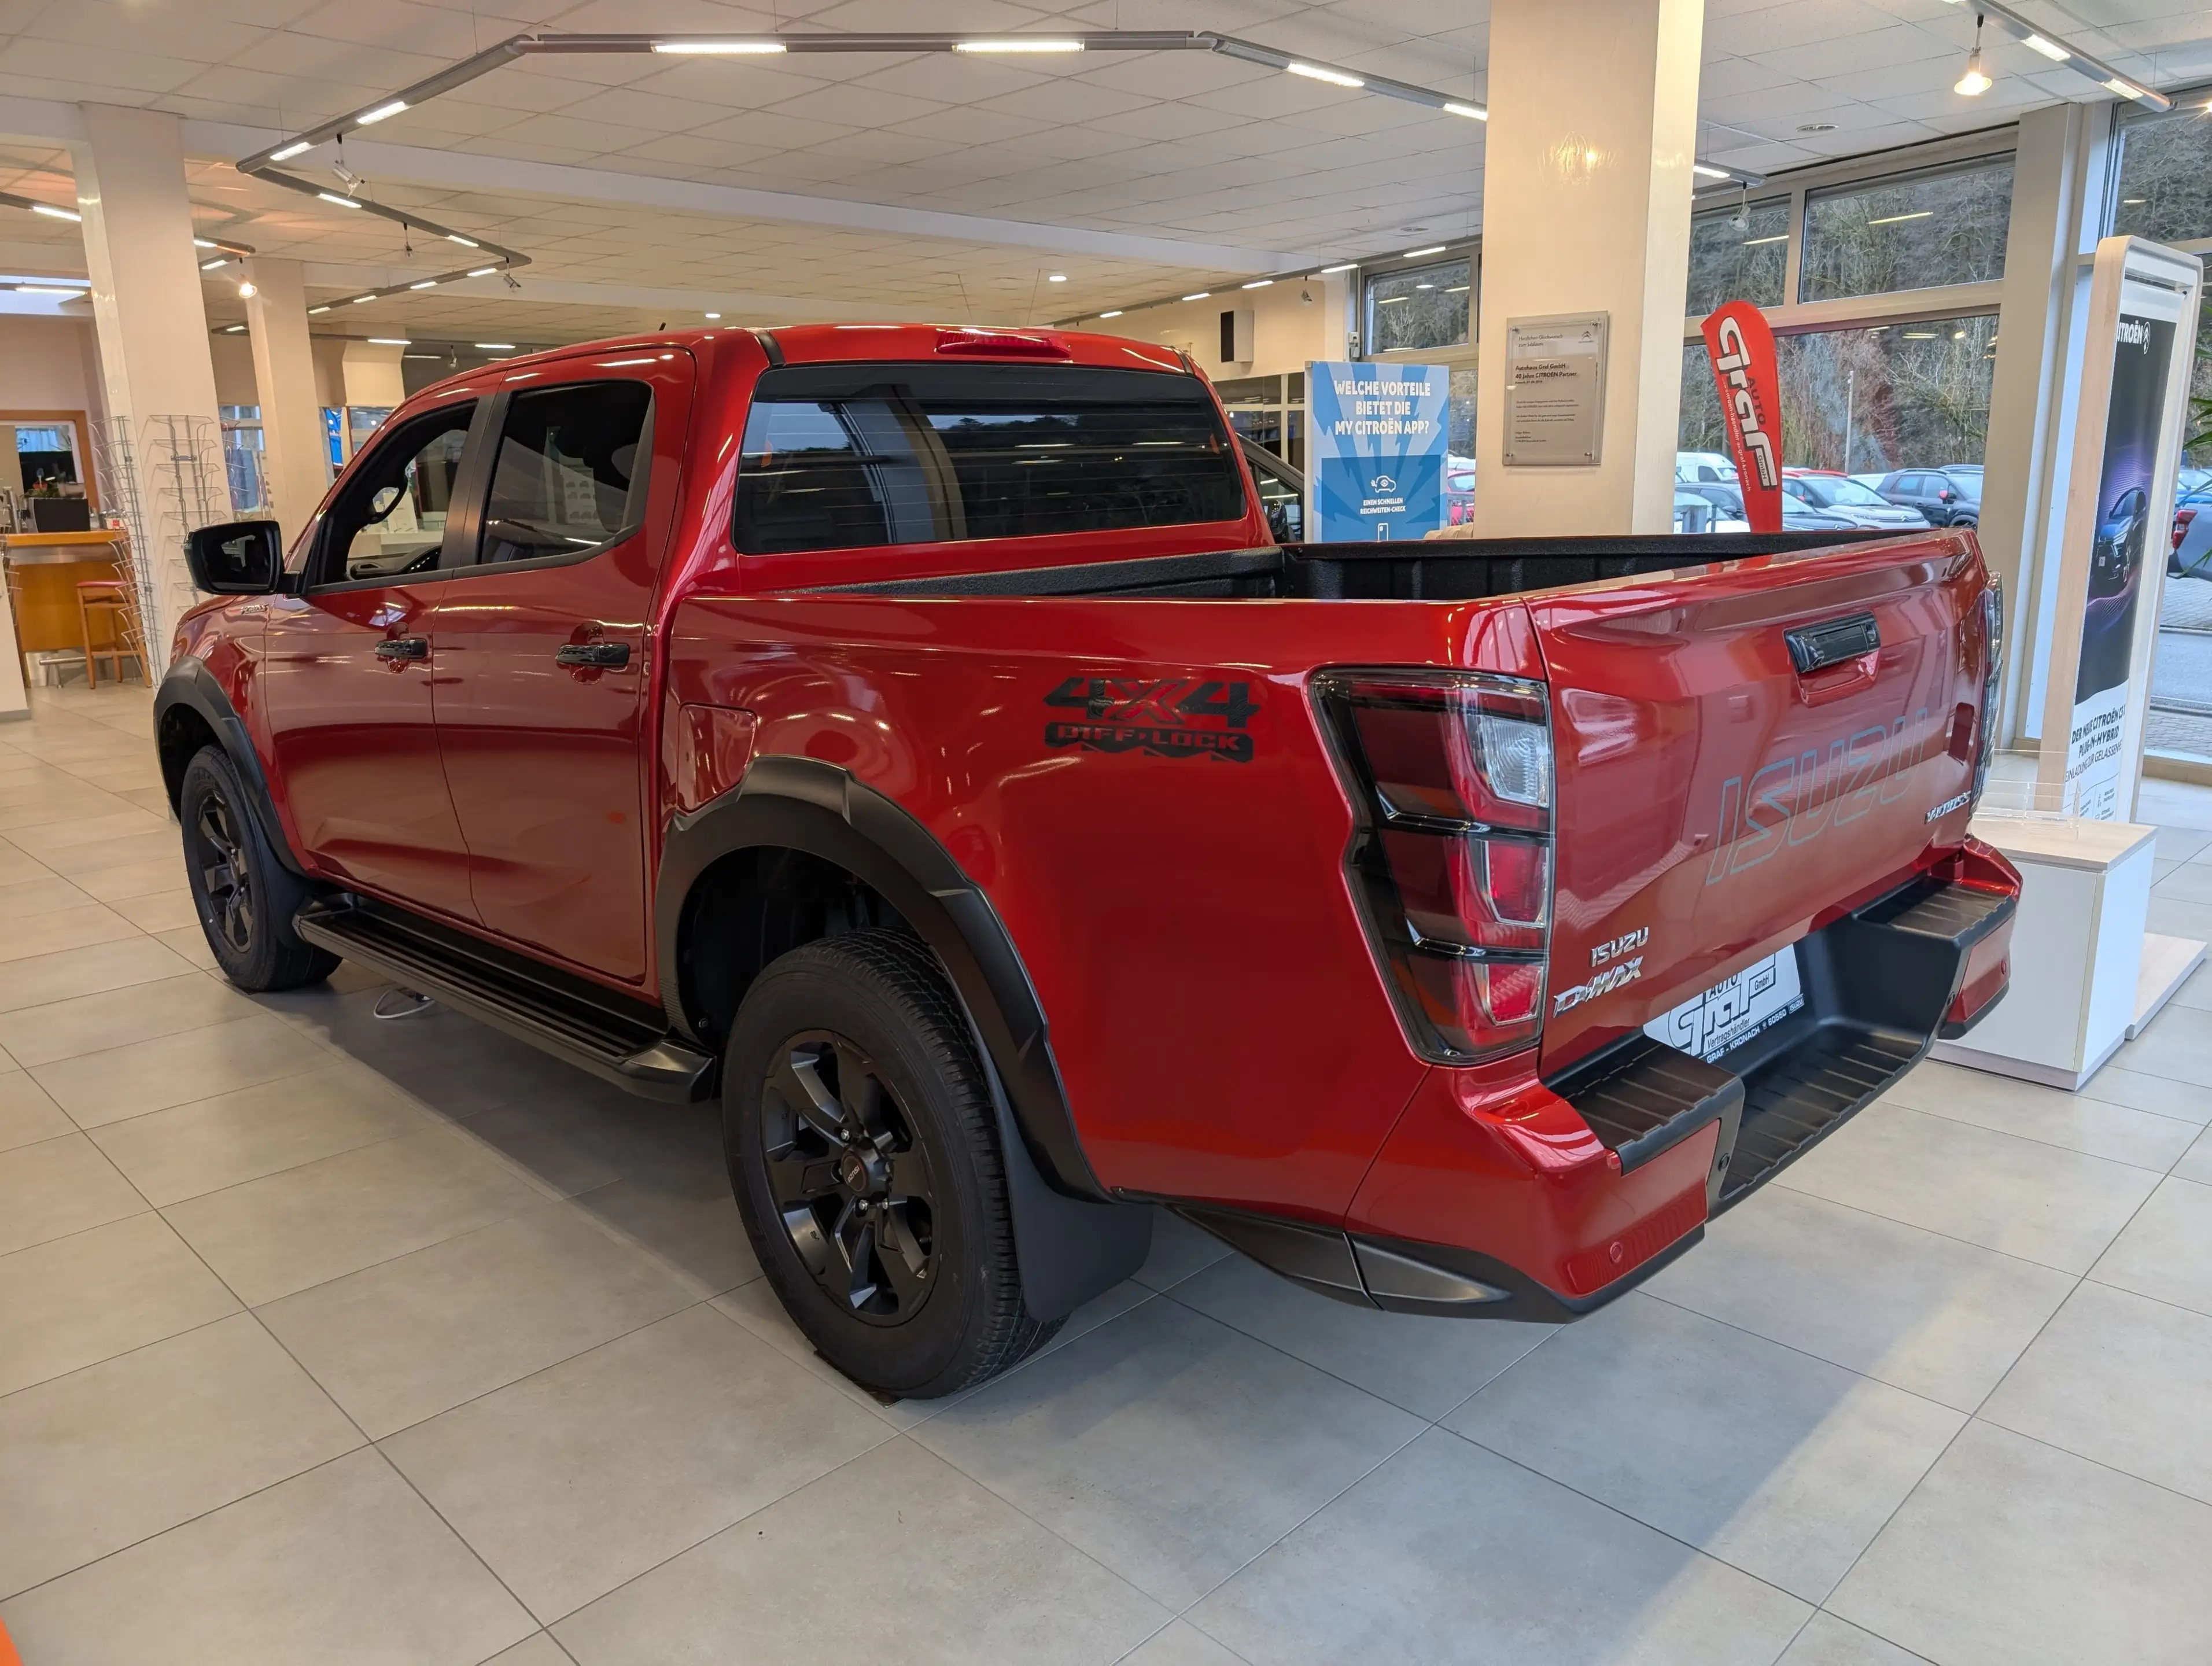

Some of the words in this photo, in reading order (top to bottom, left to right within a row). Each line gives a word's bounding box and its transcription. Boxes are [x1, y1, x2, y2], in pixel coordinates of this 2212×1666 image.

[2117, 320, 2143, 344] ITROËN
[1334, 380, 1379, 395] WELCHE
[1381, 381, 1431, 396] VORTEILE
[1356, 401, 1392, 415] BIETET
[1395, 401, 1411, 415] DIE
[1748, 377, 1766, 425] AUTO
[1335, 421, 1353, 435] MY
[1355, 417, 1402, 435] CITROËN
[1404, 421, 1429, 434] APP?
[1758, 455, 1768, 480] GmbH
[1360, 506, 1406, 514] REICHWEITEN-CHECK
[2071, 727, 2082, 744] DER
[2082, 721, 2093, 739] NEUE
[2093, 707, 2119, 731] CITROËN
[2078, 725, 2119, 758] PLUG-IN-HYBRID
[2065, 758, 2088, 783] EINLADUNG
[1706, 707, 1927, 886] ISUZU
[1591, 926, 1649, 968] ISUZU
[1709, 973, 1738, 998] AUTO
[1754, 973, 1769, 991] GmbH
[1789, 998, 1803, 1011] ISUZU
[1706, 1047, 1724, 1064] GRAF
[1730, 1025, 1760, 1051] KRONACH
[1767, 1008, 1787, 1026] 60550
[1708, 1018, 1750, 1050] Vertragshändler
[847, 1165, 860, 1183] ISUZU
